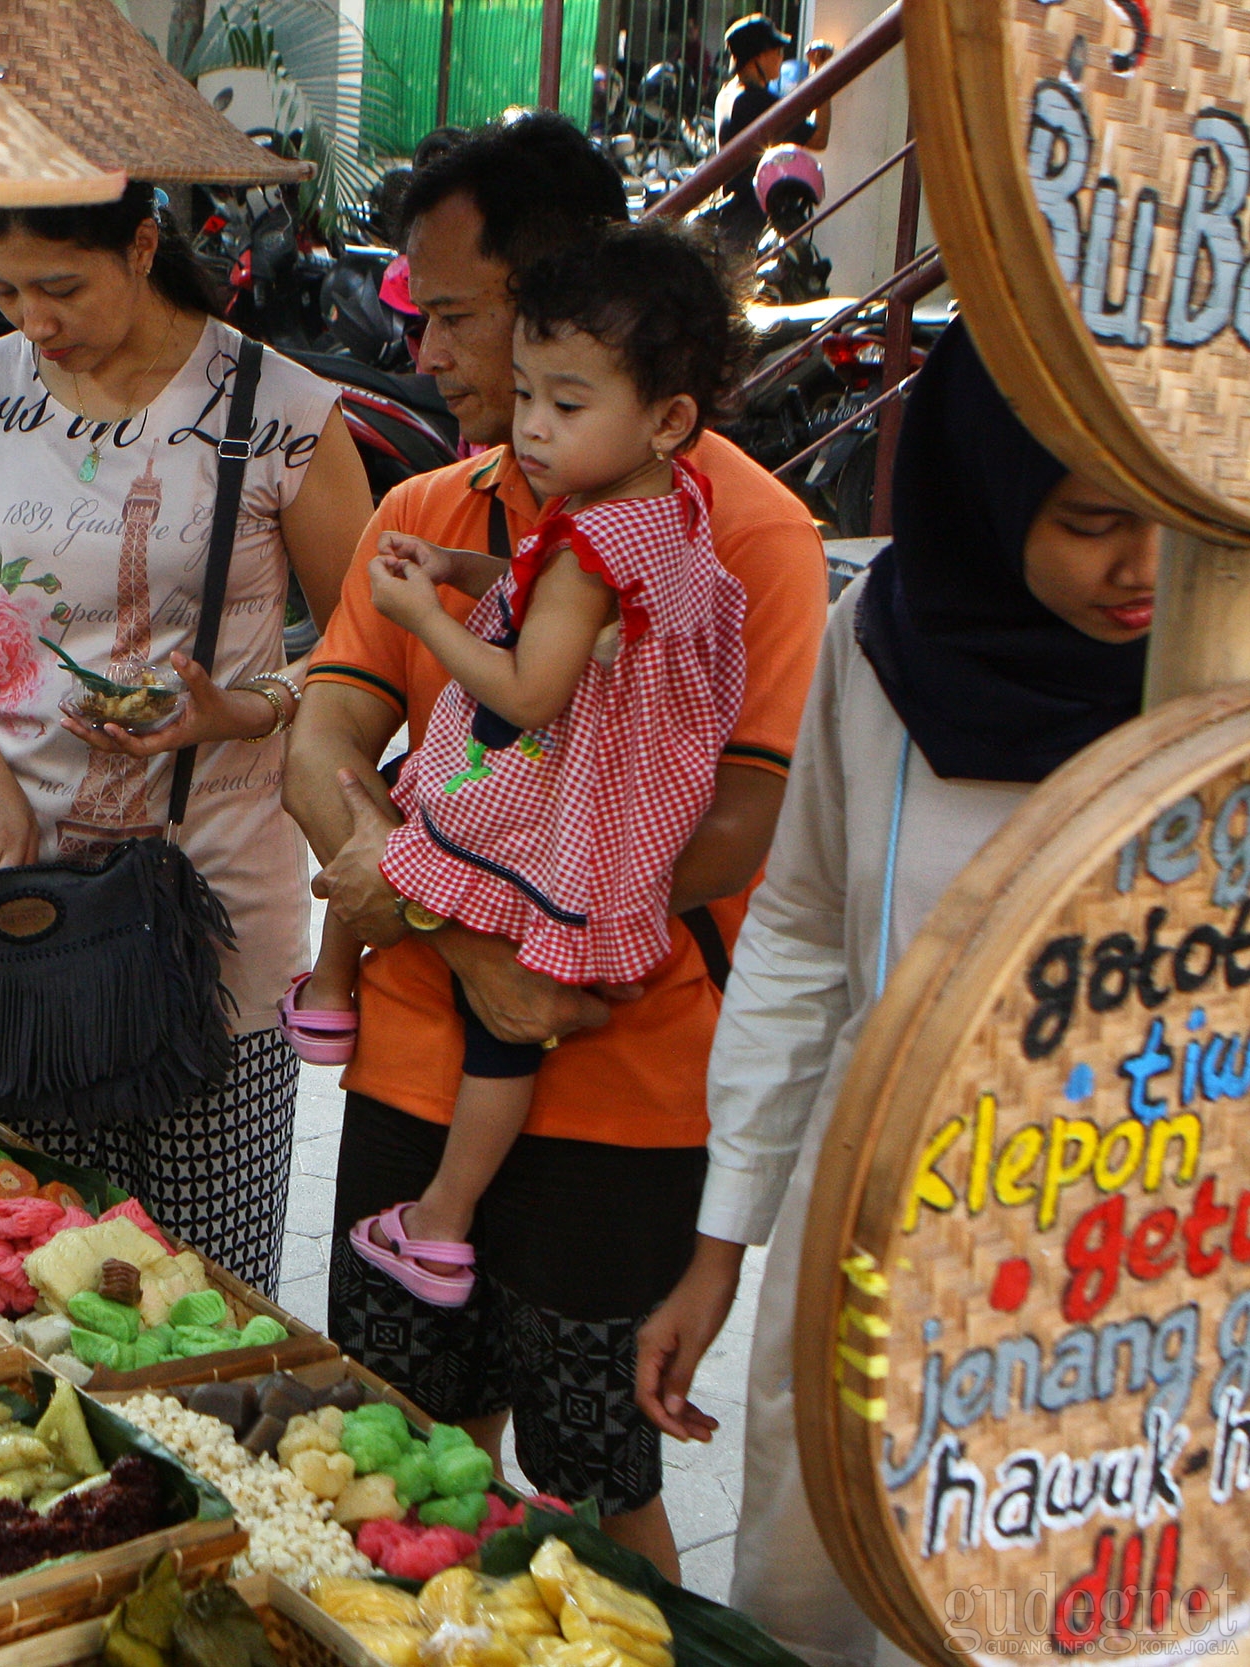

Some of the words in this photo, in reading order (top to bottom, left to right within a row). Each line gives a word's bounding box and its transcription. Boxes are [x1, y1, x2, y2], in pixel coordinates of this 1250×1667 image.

[168, 350, 319, 468] Lve
[52, 496, 171, 558] Guste
[883, 1303, 1199, 1492] jenang
